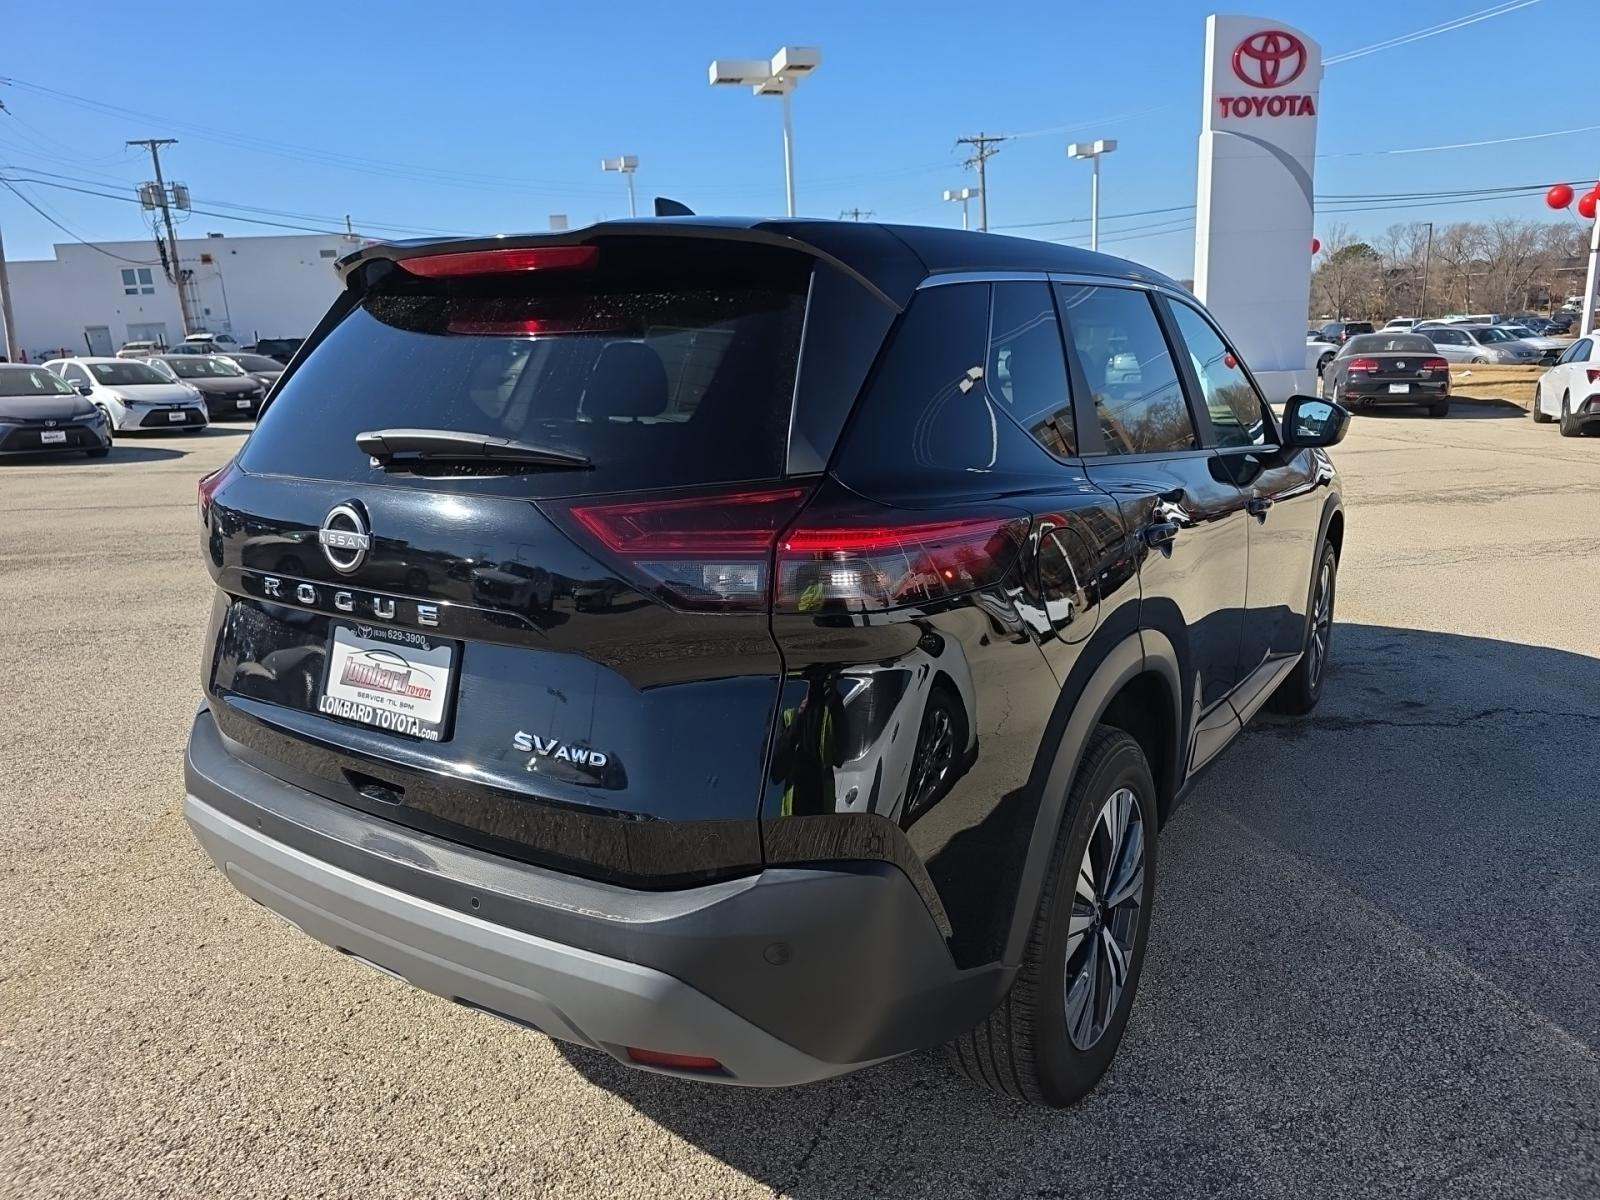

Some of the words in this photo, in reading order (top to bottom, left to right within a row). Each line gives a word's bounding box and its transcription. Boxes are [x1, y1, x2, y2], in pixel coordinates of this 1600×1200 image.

[1219, 95, 1315, 118] TOYOTA
[320, 530, 369, 548] NISSAN
[264, 577, 440, 626] ROGUE
[387, 629, 426, 645] 629-3900
[357, 691, 385, 704] SERVICE
[406, 685, 432, 699] TOYOTA
[319, 695, 373, 722] LOMBARD
[375, 709, 438, 741] TOYOTA.com
[554, 746, 607, 767] AWD
